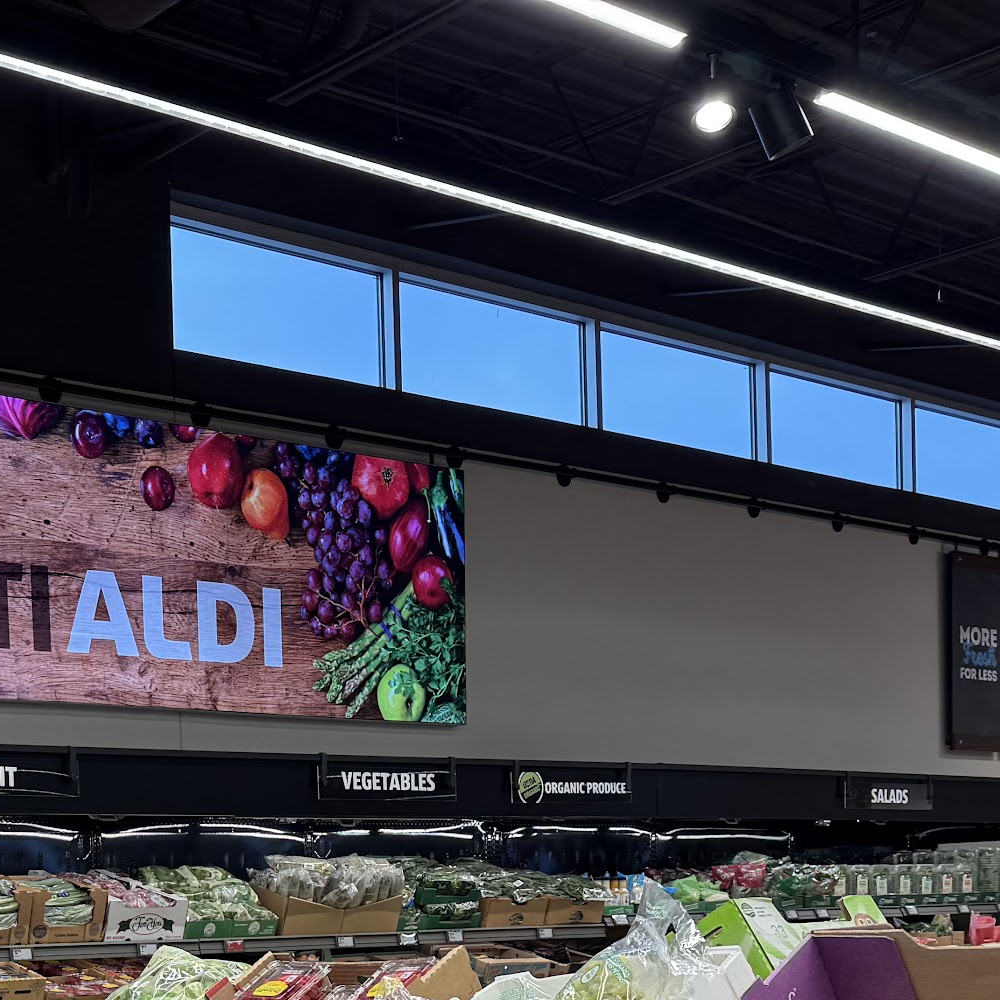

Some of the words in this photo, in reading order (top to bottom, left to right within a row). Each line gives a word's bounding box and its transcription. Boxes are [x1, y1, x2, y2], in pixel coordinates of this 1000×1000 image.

[67, 570, 284, 668] ALDI
[960, 625, 998, 648] MORE
[960, 667, 977, 680] FOR
[978, 668, 998, 682] LESS
[341, 770, 436, 793] VEGETABLES
[544, 781, 586, 794] ORGANIC
[587, 782, 627, 795] PRODUCE
[870, 788, 909, 805] SALADS
